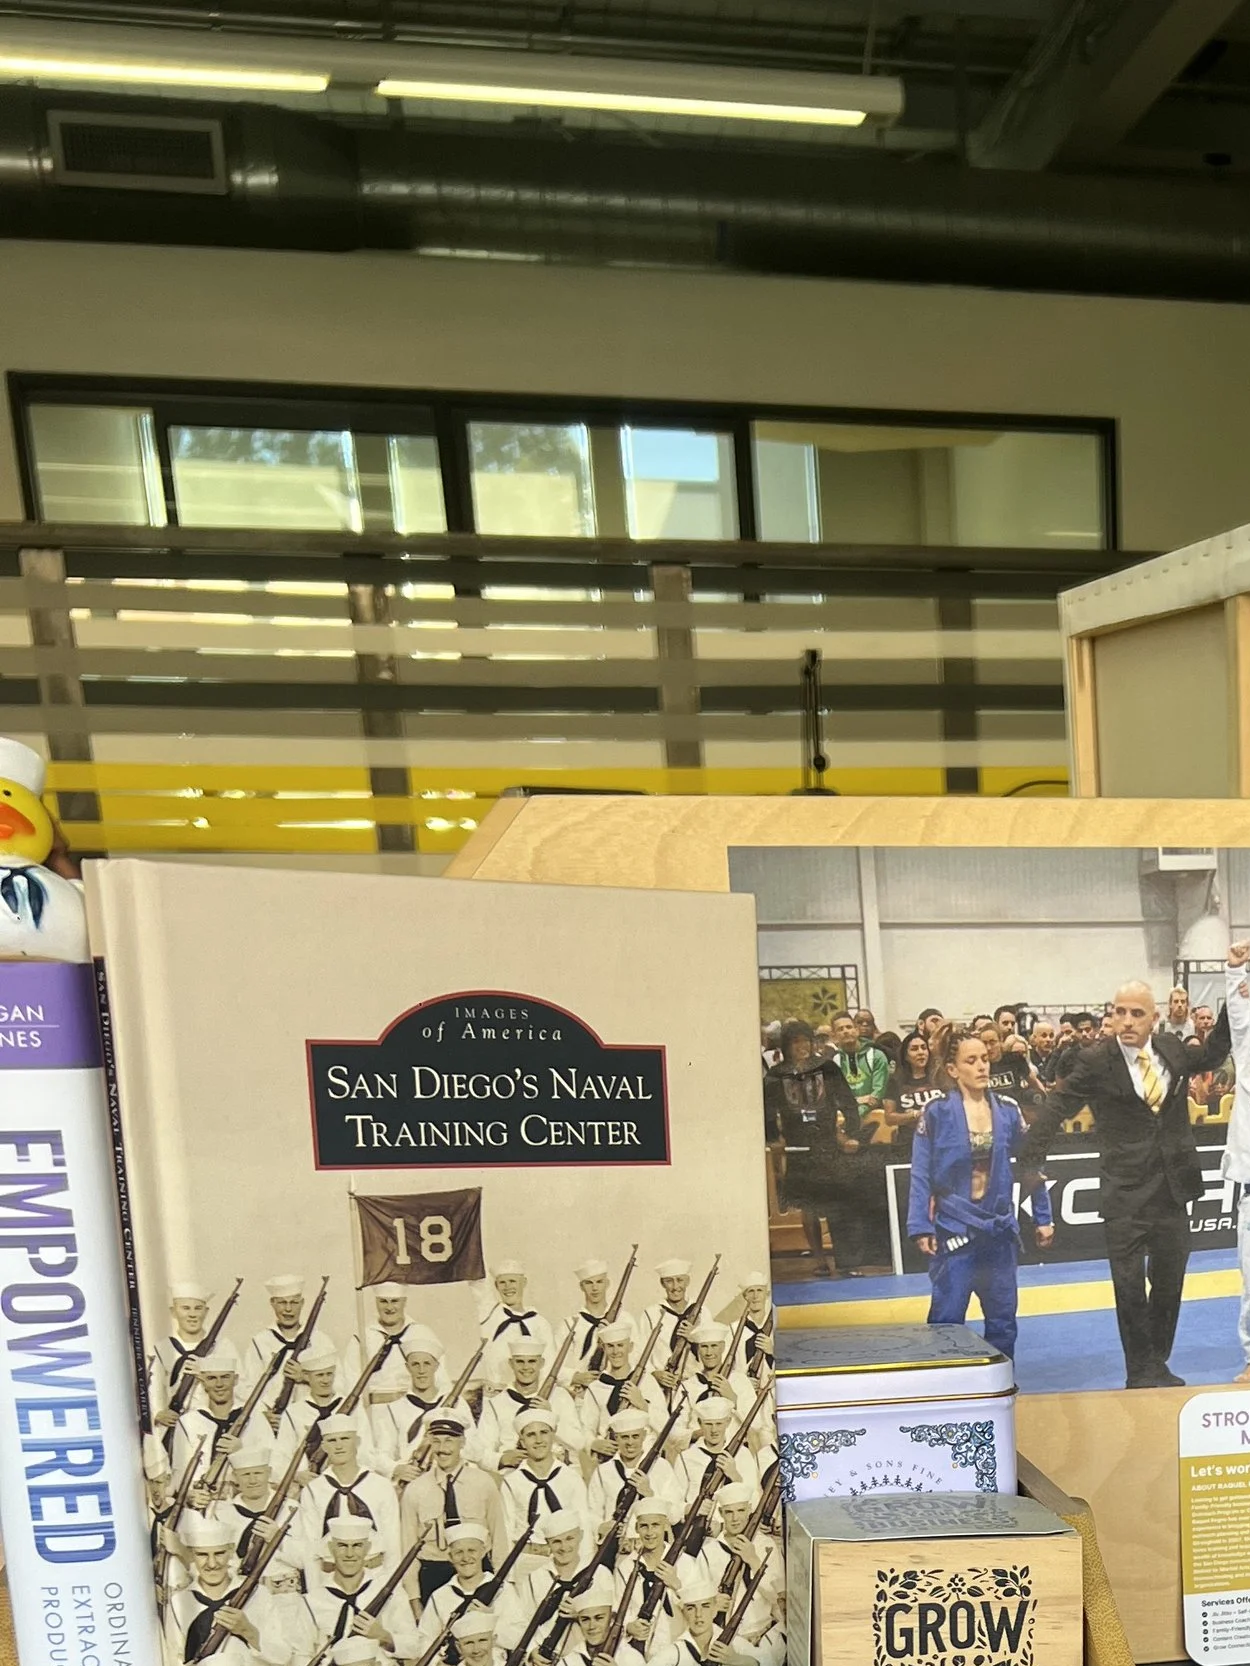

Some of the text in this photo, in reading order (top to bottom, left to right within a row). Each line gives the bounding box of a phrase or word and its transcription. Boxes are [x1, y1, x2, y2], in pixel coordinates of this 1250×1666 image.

[455, 1007, 530, 1020] IMAGES
[422, 1022, 562, 1042] of America
[392, 1215, 454, 1265] 18
[0, 1129, 117, 1564] EMPOWERED
[866, 1460, 903, 1471] SONS
[912, 1464, 943, 1484] FINE
[1191, 1465, 1223, 1478] Let's
[1201, 1598, 1235, 1607] Services
[885, 1600, 1030, 1658] GROW
